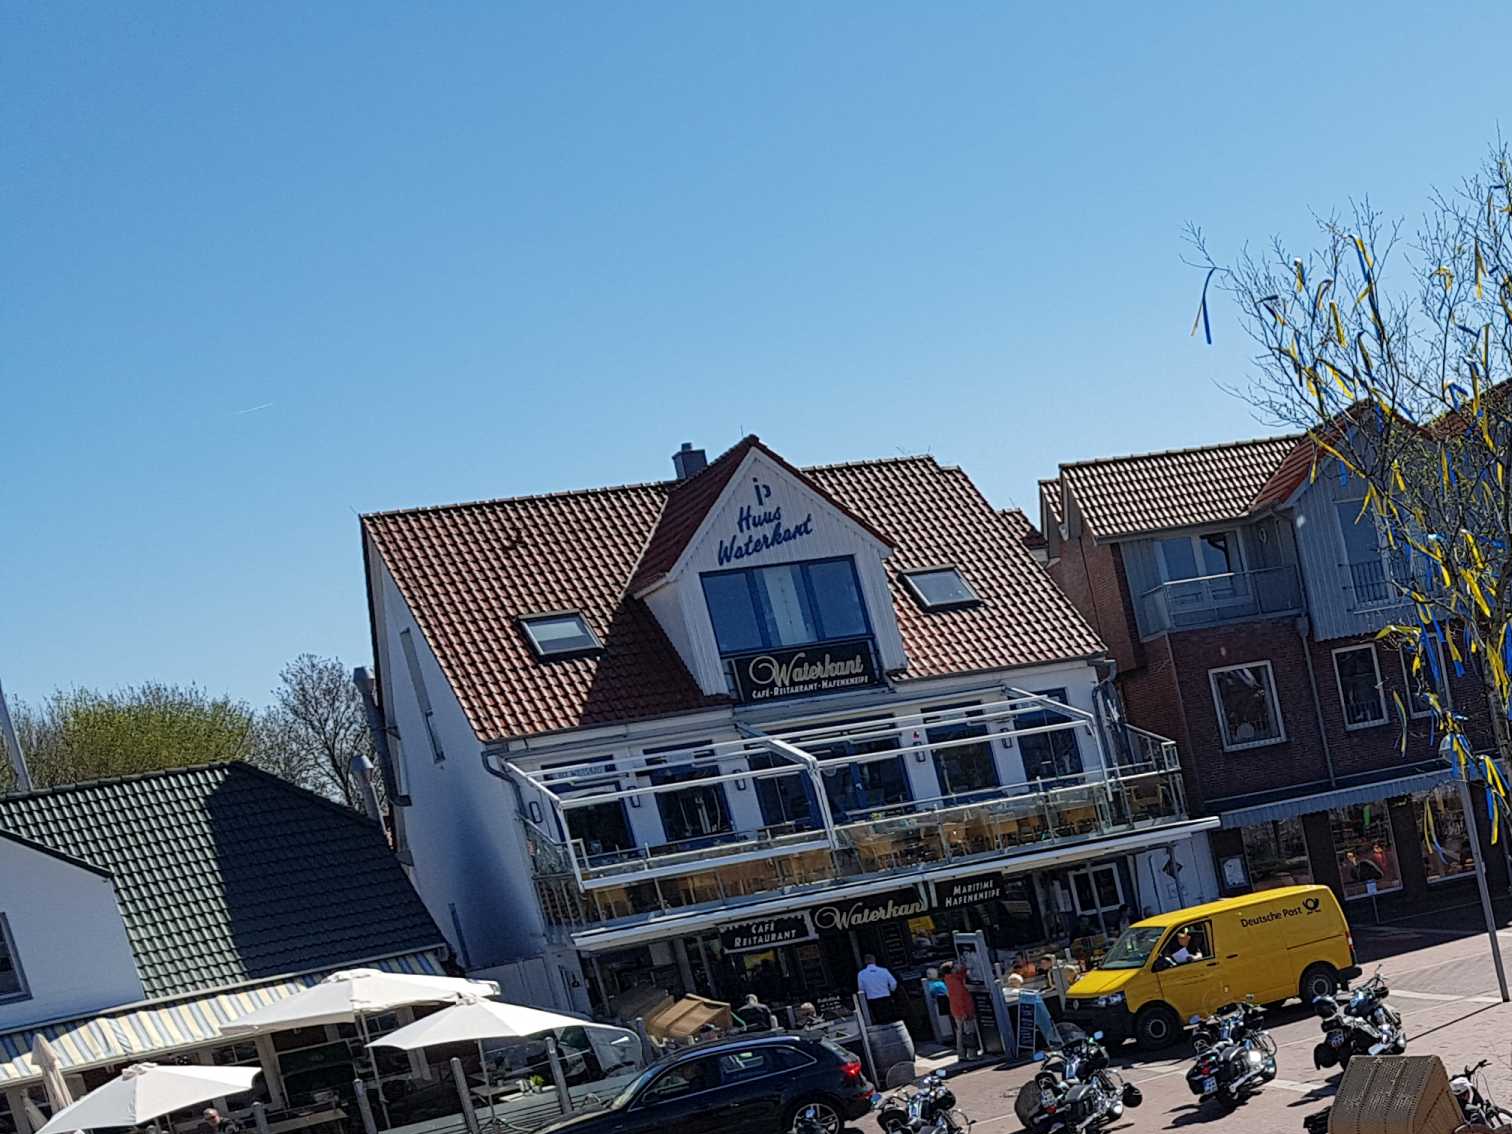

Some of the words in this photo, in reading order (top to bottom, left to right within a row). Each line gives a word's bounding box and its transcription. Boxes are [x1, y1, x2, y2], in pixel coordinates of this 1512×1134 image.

[737, 505, 782, 533] Huus
[718, 513, 813, 566] Waterkant
[749, 651, 864, 687] Waterkant
[944, 887, 1001, 908] HAFENKNEIPE
[952, 879, 994, 897] MARITIME
[1240, 909, 1283, 929] Deutsche
[1281, 905, 1302, 921] Post
[734, 928, 797, 948] RESTAURANT
